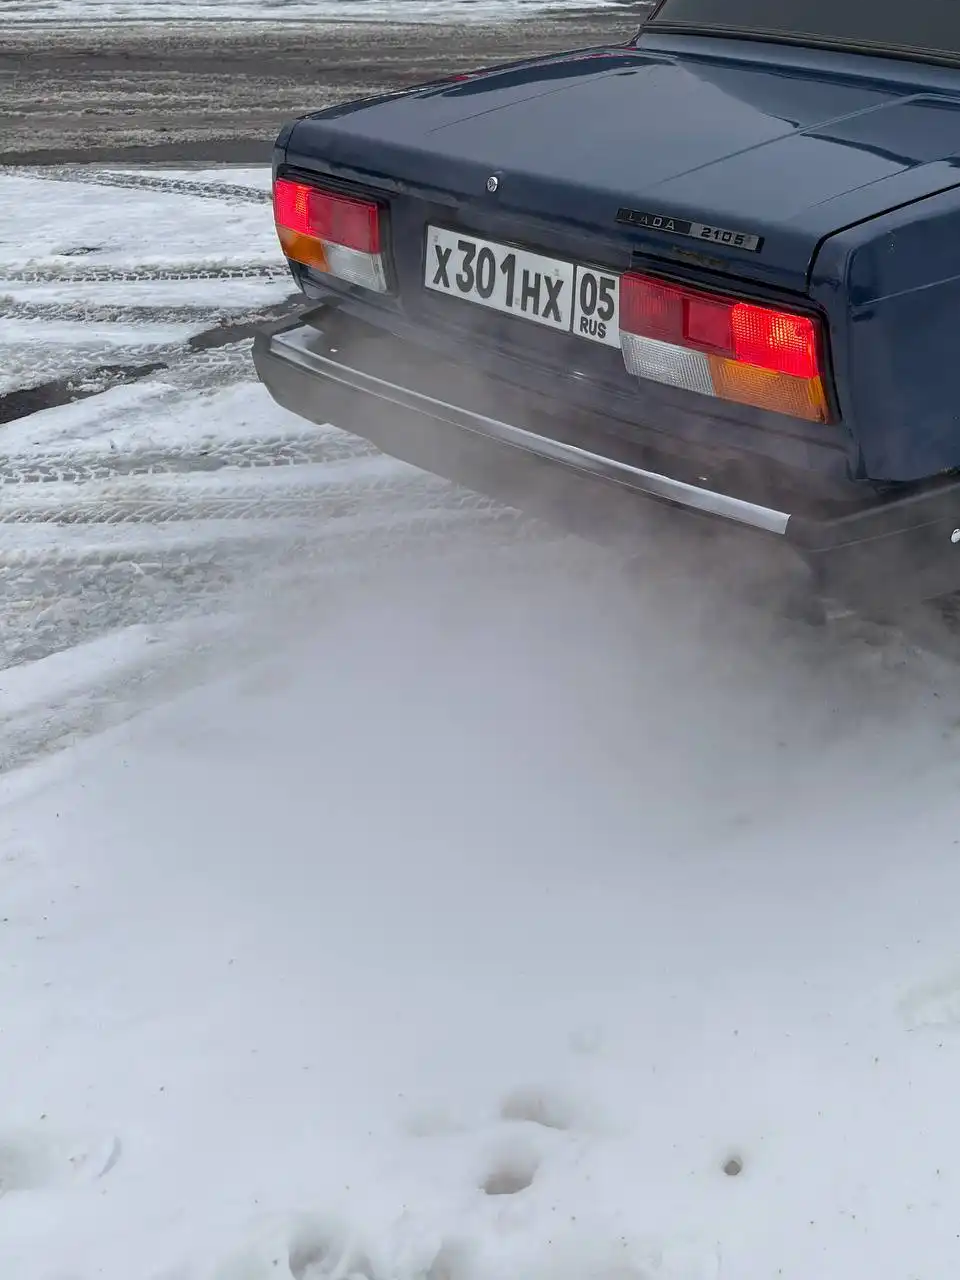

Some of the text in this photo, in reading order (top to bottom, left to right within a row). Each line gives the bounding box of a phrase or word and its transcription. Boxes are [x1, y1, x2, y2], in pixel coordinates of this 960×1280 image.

[701, 227, 745, 246] 2105
[579, 272, 616, 322] 05
[579, 316, 607, 339] RUS
